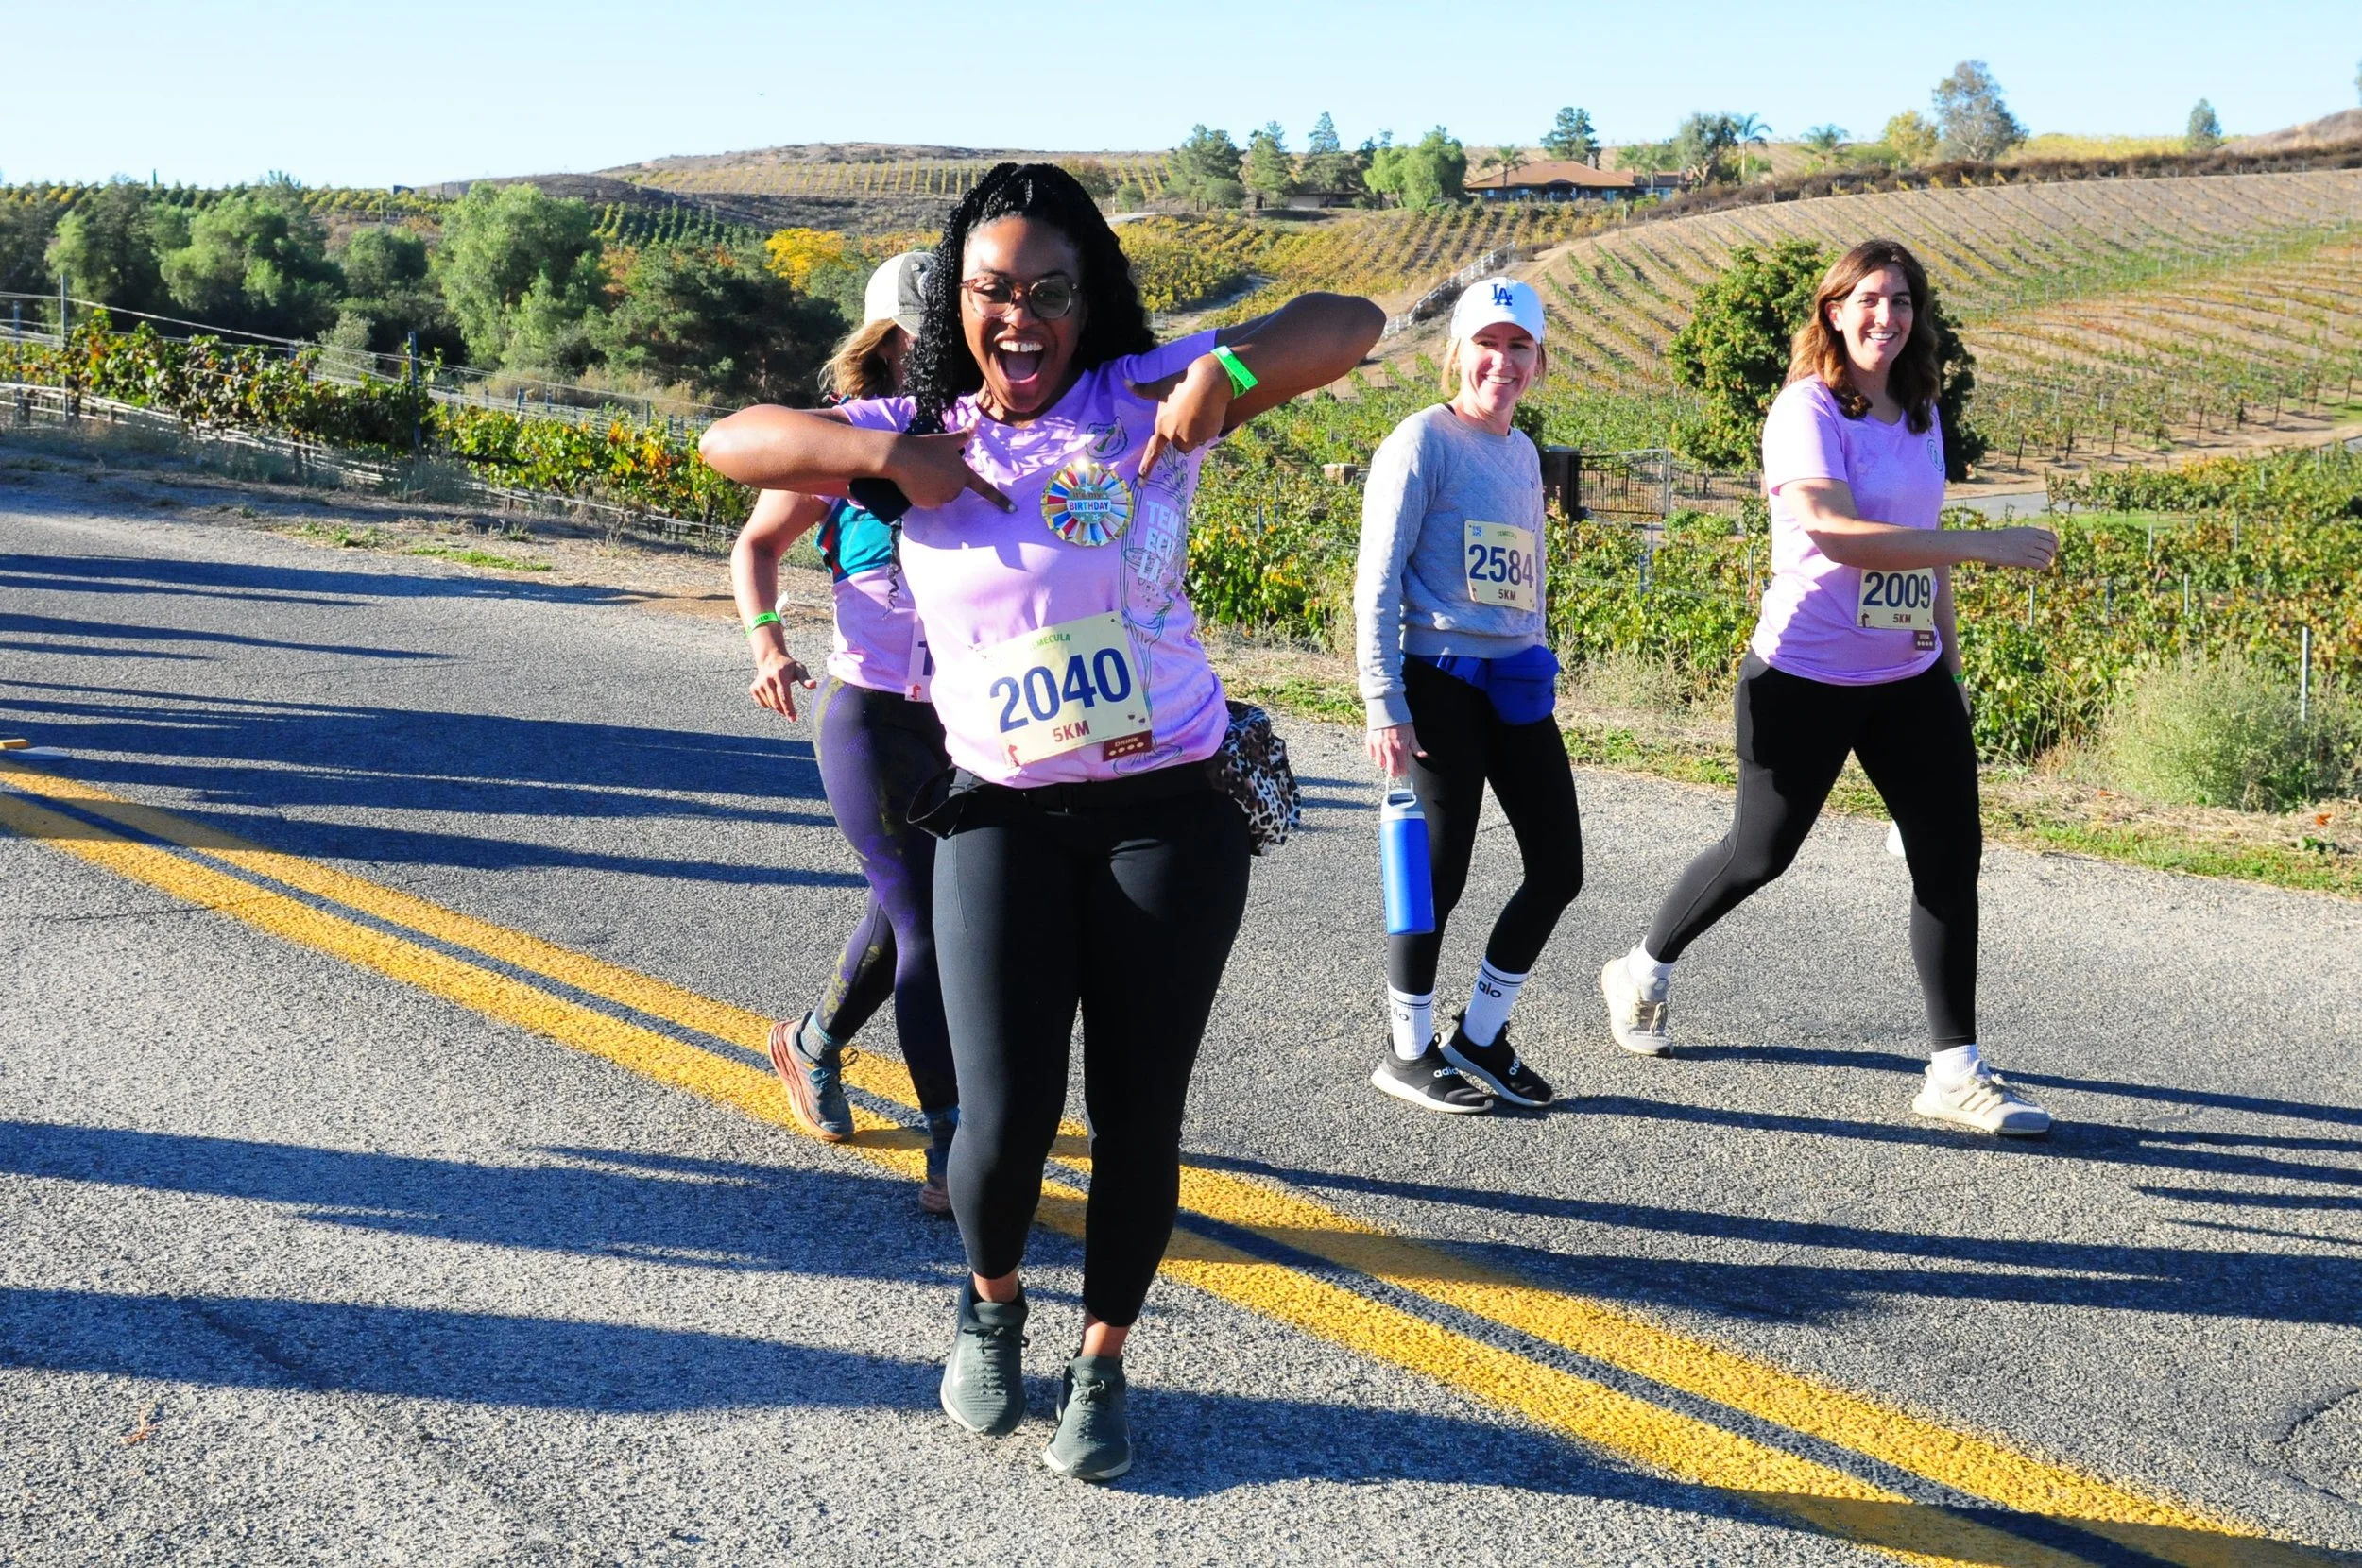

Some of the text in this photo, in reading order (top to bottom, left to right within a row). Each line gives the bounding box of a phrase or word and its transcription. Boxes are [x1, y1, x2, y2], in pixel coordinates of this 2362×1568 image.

[1491, 284, 1513, 306] LA
[1070, 502, 1108, 511] BIRTHDAY
[1468, 544, 1533, 588] 2584
[1498, 588, 1516, 601] 5KM
[1862, 571, 1930, 609] 2009
[1892, 613, 1911, 623] 5KM
[1031, 633, 1070, 649] MECULA
[989, 648, 1131, 733] 2040
[1053, 720, 1090, 742] 5KM
[1115, 737, 1138, 747] DRINK
[1479, 980, 1501, 997] alo
